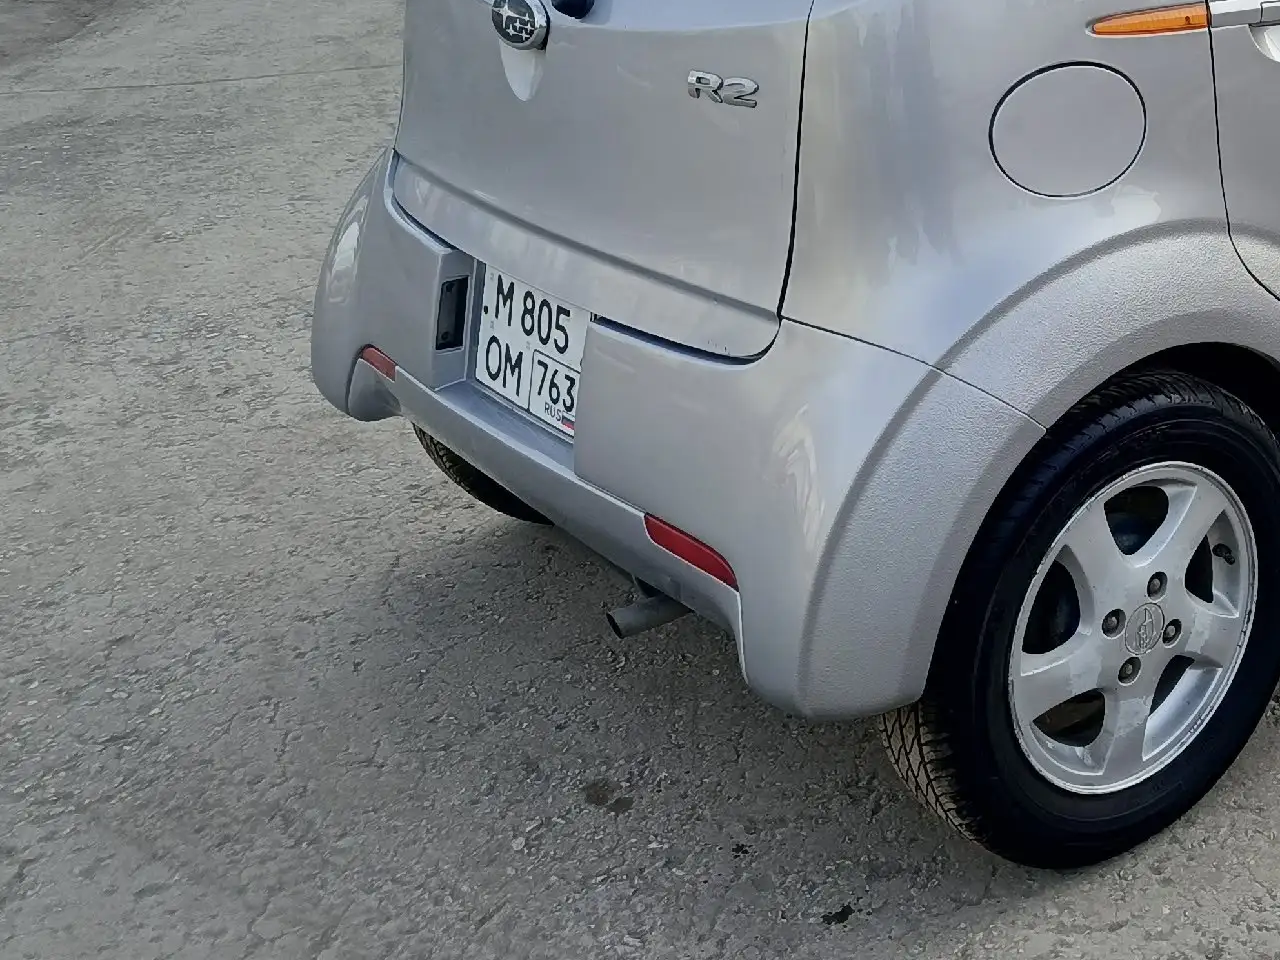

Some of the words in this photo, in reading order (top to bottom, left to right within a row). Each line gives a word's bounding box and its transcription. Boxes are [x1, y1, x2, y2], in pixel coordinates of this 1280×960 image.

[687, 68, 759, 109] R2
[494, 273, 515, 327] М
[520, 290, 571, 354] 805
[485, 334, 523, 397] ОМ
[537, 359, 576, 413] 763
[544, 401, 562, 422] RUS
